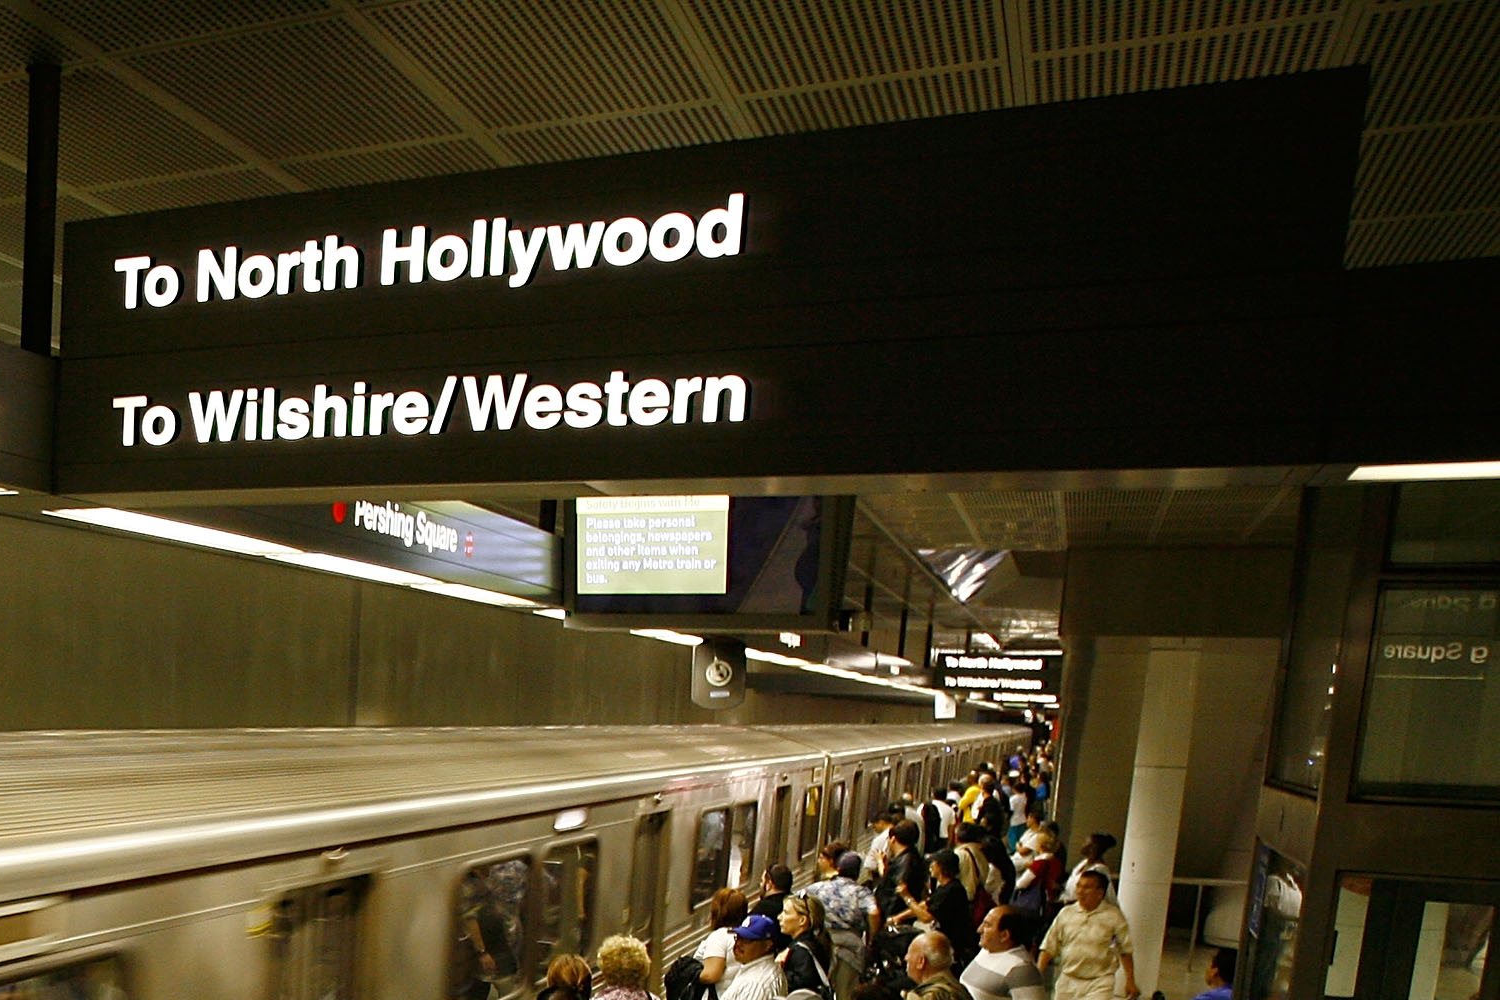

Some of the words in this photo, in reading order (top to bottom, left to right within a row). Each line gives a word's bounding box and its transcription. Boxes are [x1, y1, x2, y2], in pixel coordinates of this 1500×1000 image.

[114, 255, 179, 310] To
[196, 234, 360, 304] North
[379, 192, 745, 289] Hollywood
[112, 395, 177, 446] To
[188, 370, 747, 444] Wilshire/Western
[587, 499, 618, 511] Safety
[354, 500, 414, 547] Pershing
[415, 511, 458, 553] Square
[586, 517, 621, 529] Please
[623, 516, 646, 528] take
[648, 515, 696, 530] personal
[585, 531, 645, 544] belongings,
[647, 531, 713, 544] newspapers
[585, 545, 606, 557] and
[607, 545, 636, 557] other
[637, 545, 667, 556] items
[669, 544, 699, 556] when
[585, 559, 620, 572] exiting
[622, 560, 642, 572] any
[643, 559, 674, 570] Metro
[676, 558, 702, 569] train
[704, 559, 717, 570] or
[585, 573, 609, 584] bus.
